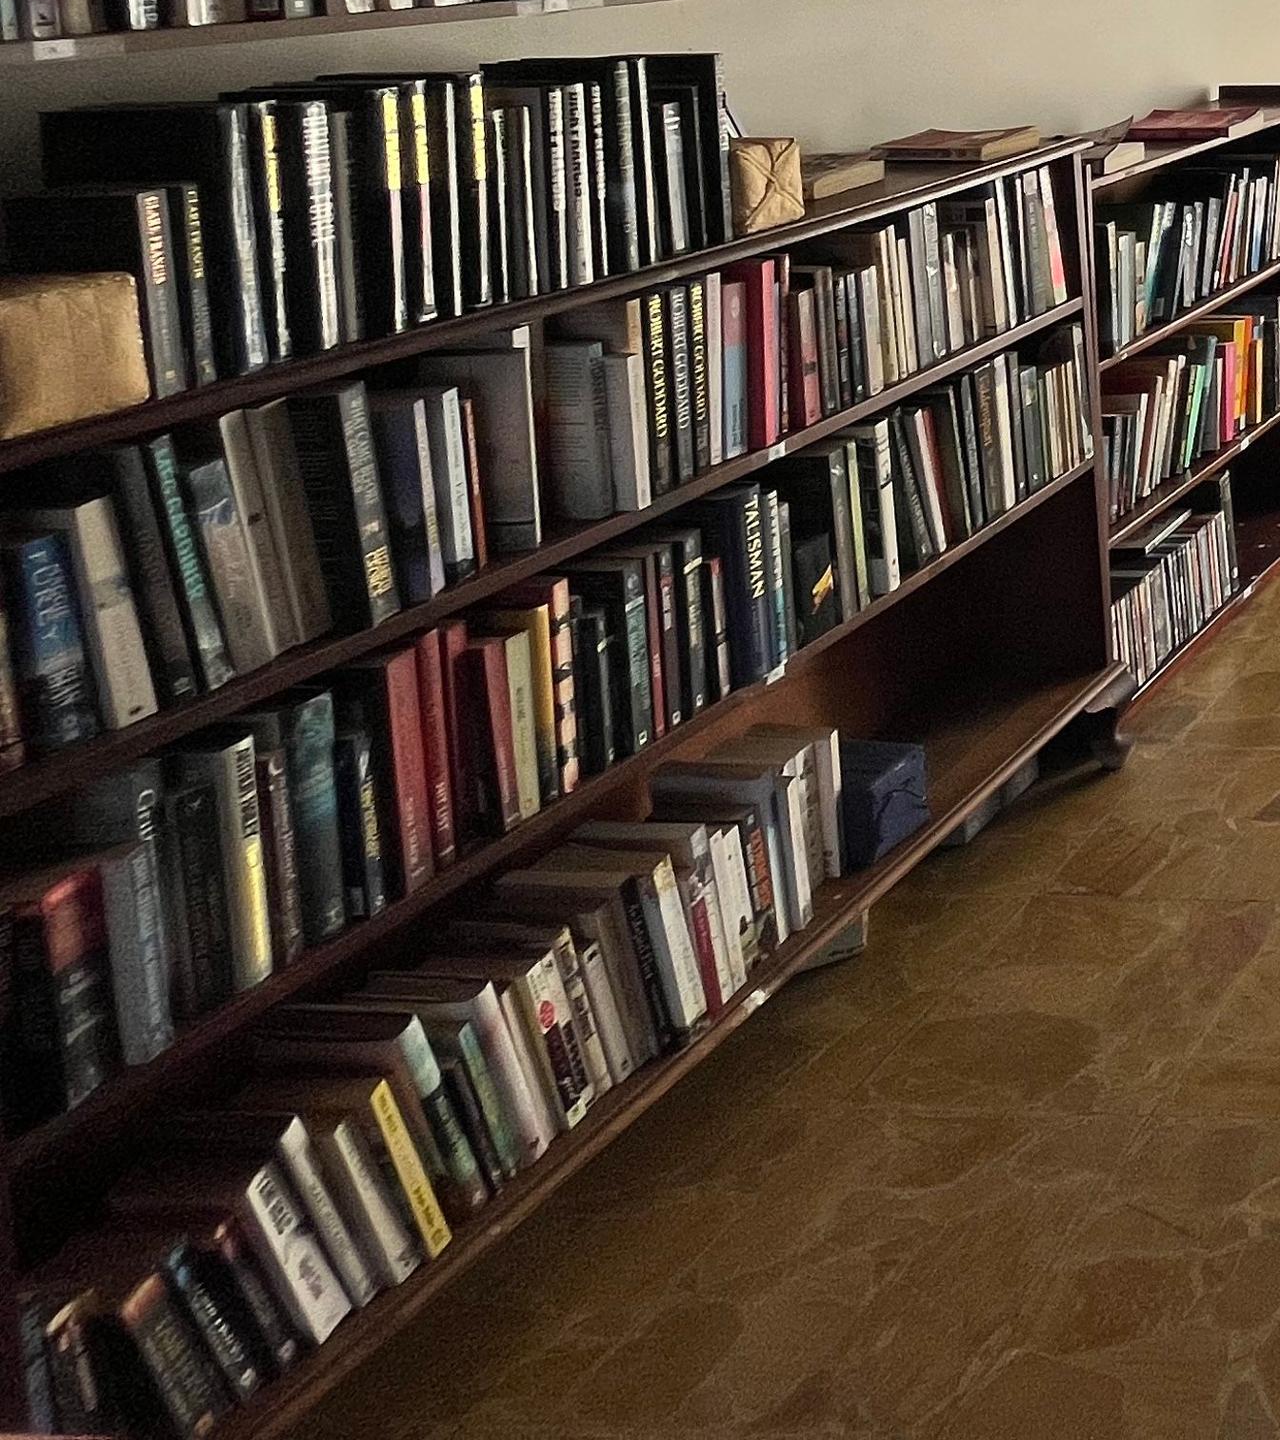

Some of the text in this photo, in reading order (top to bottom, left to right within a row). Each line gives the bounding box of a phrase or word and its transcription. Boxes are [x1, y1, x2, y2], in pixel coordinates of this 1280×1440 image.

[142, 195, 162, 235] CLARE
[148, 236, 167, 285] FRANCIS
[647, 294, 668, 438] ROBERT GODDARD
[671, 293, 690, 430] ROBERT GODDARD
[690, 283, 707, 421] ROBERT GODDARD
[350, 396, 368, 431] WHAT
[743, 495, 767, 599] TALISMAN
